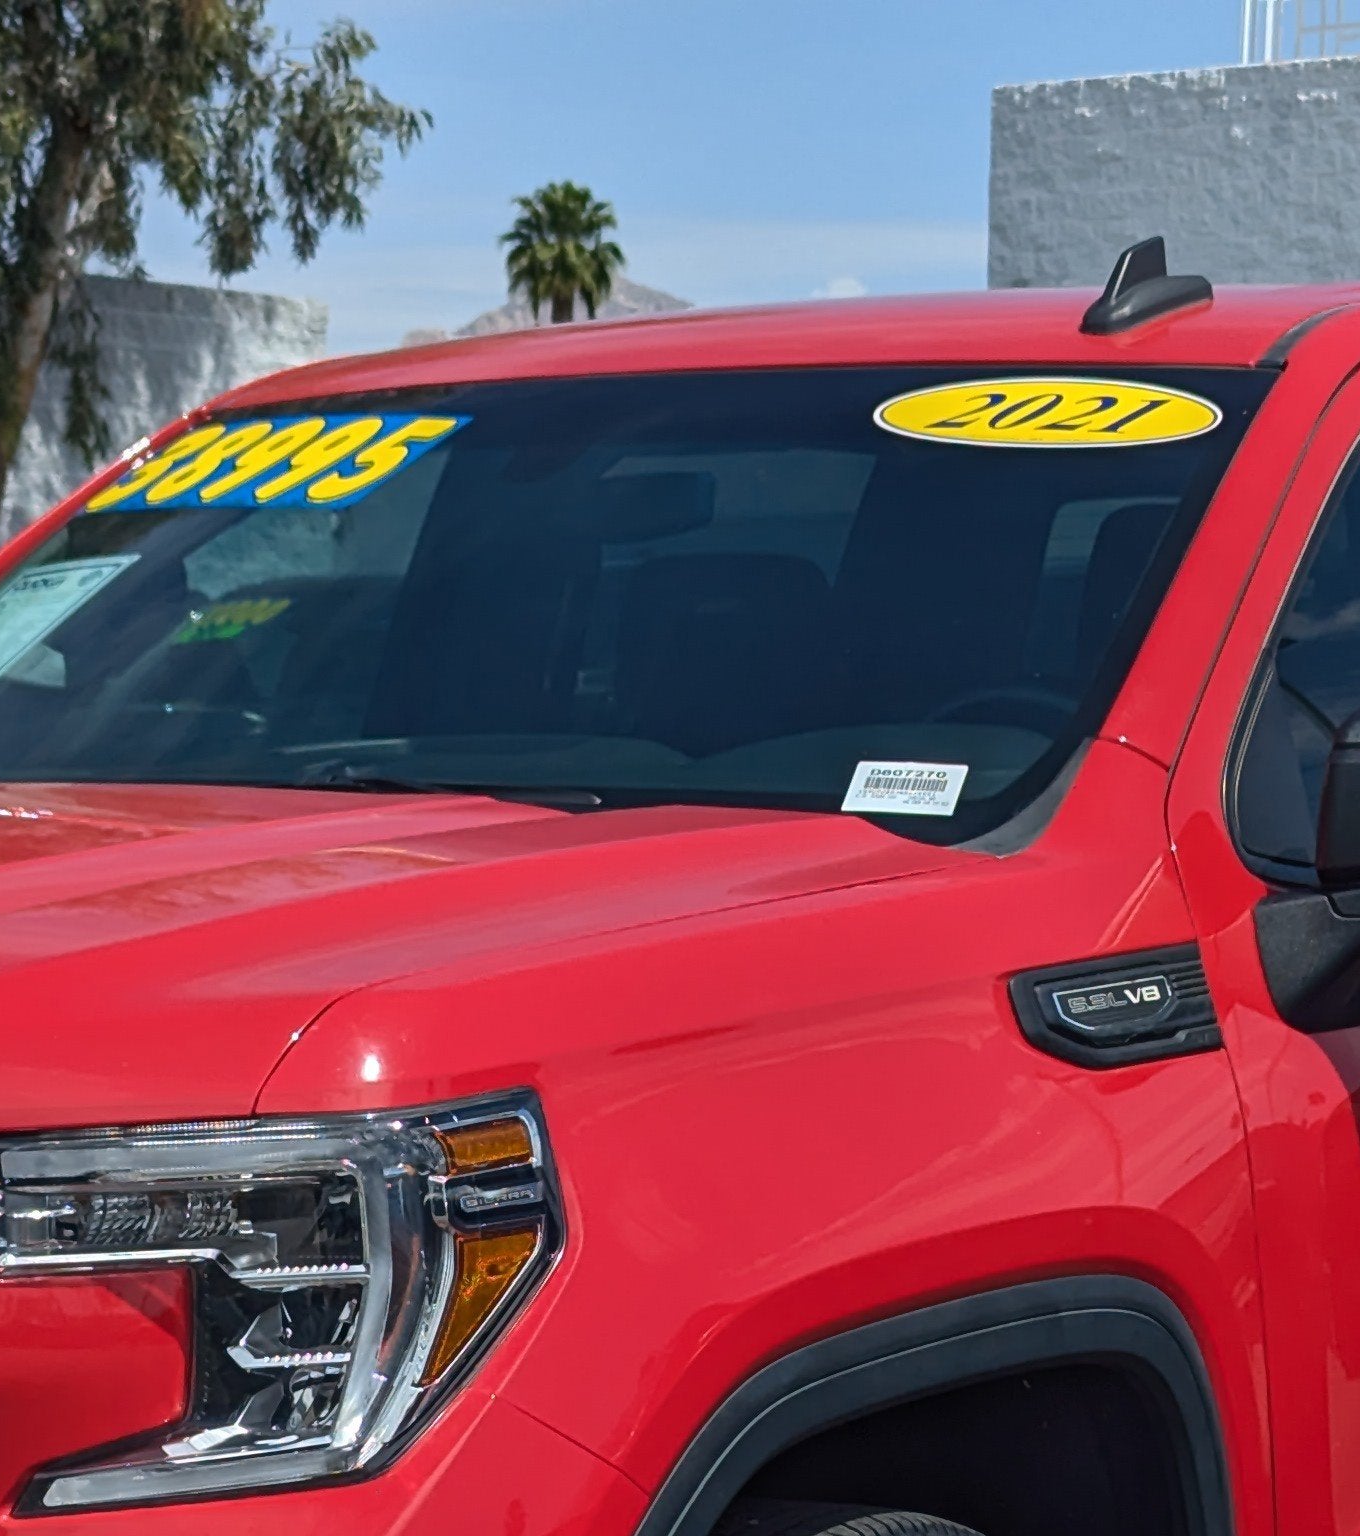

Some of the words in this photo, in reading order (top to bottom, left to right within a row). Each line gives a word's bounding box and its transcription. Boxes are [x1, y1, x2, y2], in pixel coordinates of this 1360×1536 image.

[923, 393, 1172, 434] 2021
[86, 415, 458, 512] 38995
[1123, 985, 1162, 1004] V8
